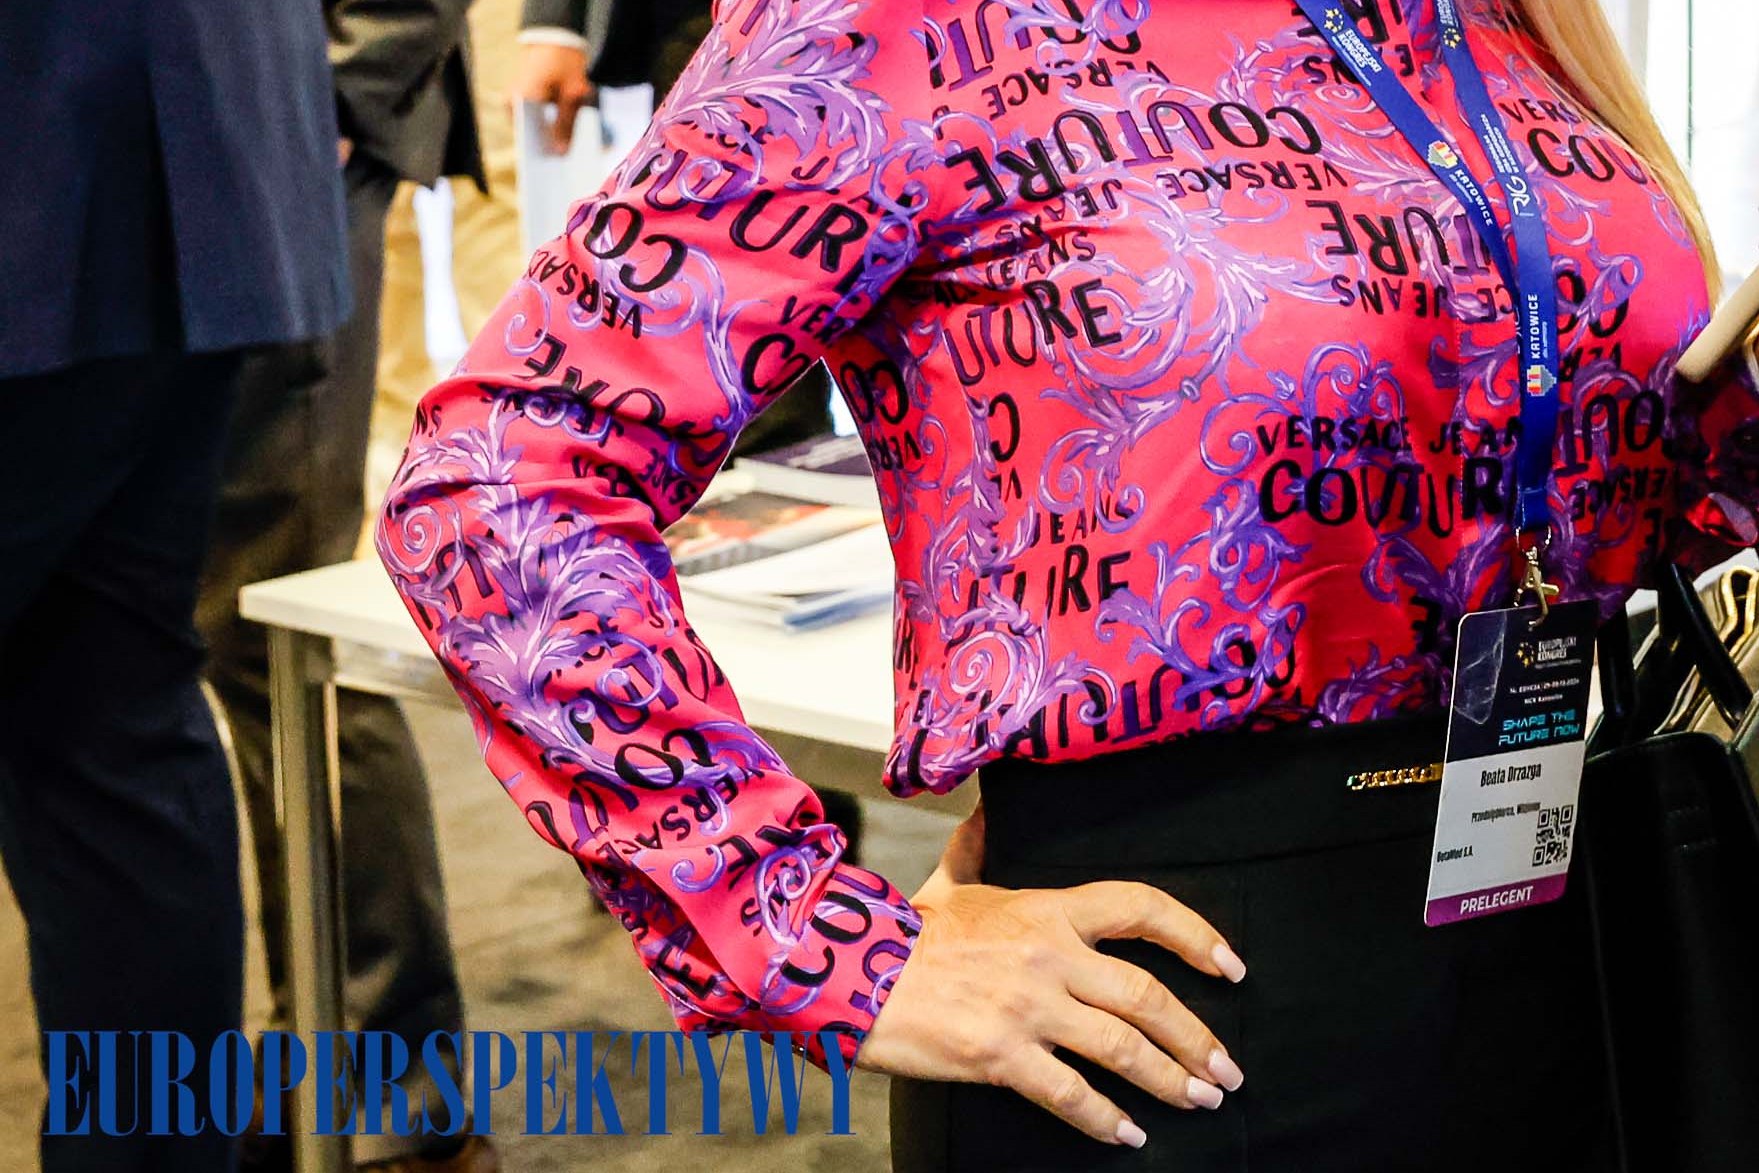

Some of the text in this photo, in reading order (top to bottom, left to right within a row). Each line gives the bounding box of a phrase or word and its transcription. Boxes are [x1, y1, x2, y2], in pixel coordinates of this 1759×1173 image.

[1345, 28, 1383, 74] EUROPEJSKI
[945, 100, 1322, 216] COUTURE
[1155, 159, 1348, 201] VERSACE
[1454, 168, 1493, 227] KATOWICE
[1527, 294, 1541, 359] KATOWICE
[1256, 414, 1412, 456] VERSACE
[1498, 723, 1580, 747] FUTURE NOW
[1503, 709, 1576, 731] SHAPE THE
[1480, 763, 1542, 788] Beata Drzazga
[1460, 886, 1534, 915] PRELEGENT
